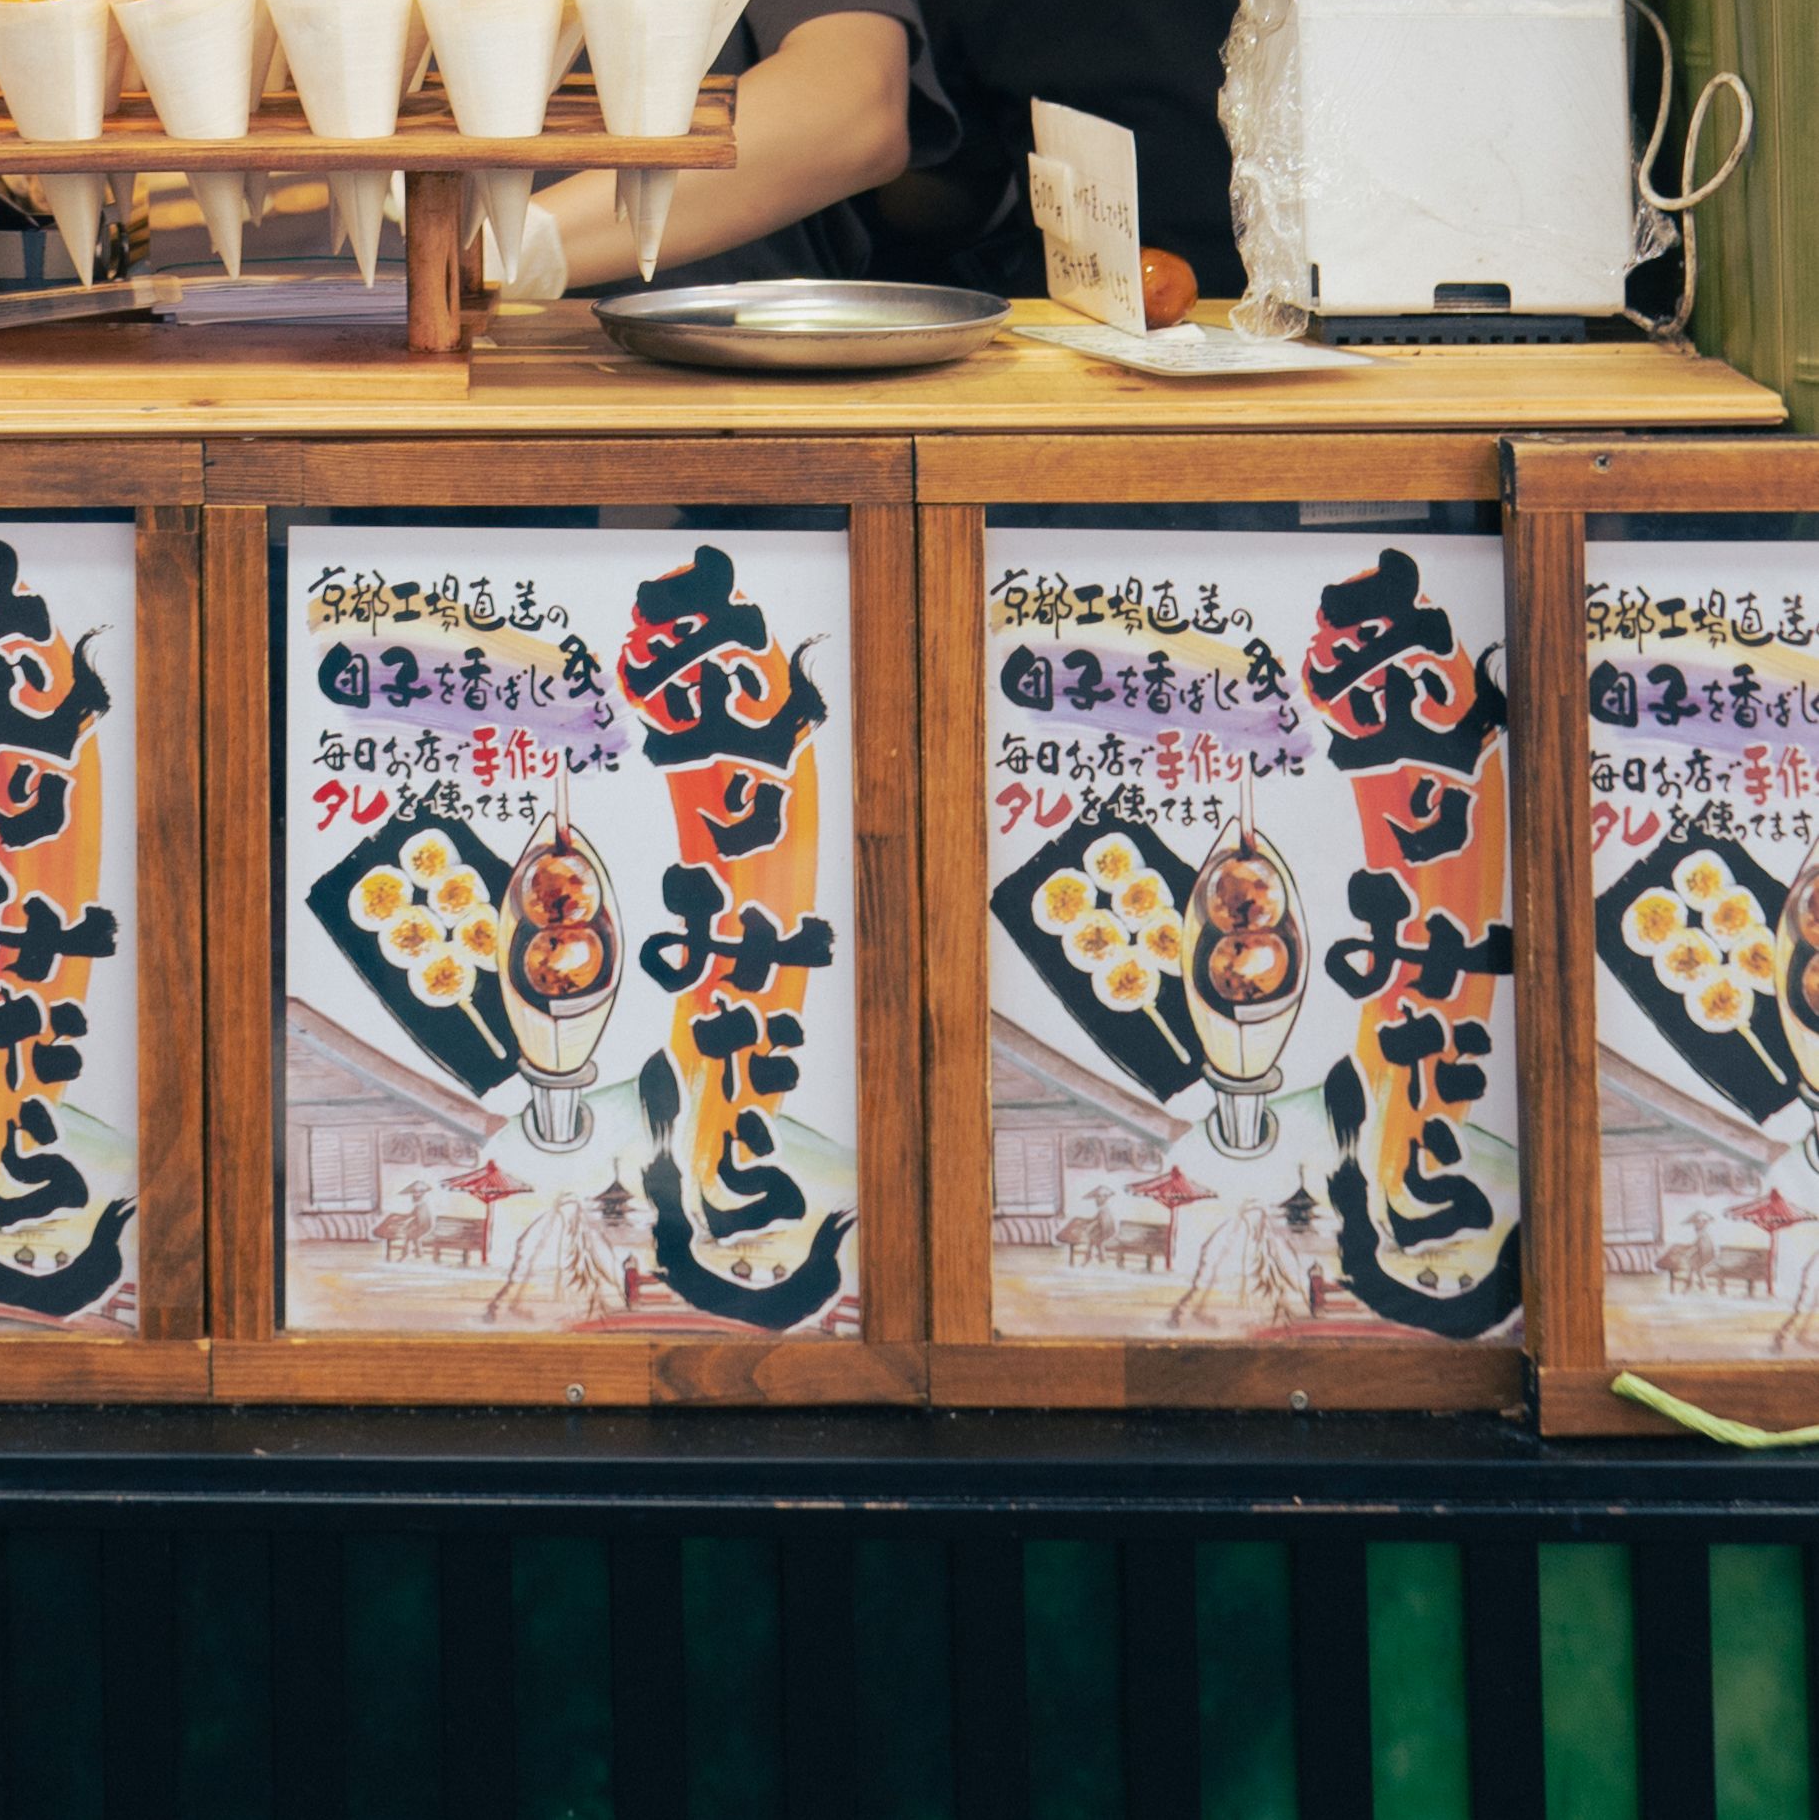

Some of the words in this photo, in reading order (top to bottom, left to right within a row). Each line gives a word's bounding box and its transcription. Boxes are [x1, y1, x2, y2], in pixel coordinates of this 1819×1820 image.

[1590, 745, 1819, 805] 毎日お店で手作
